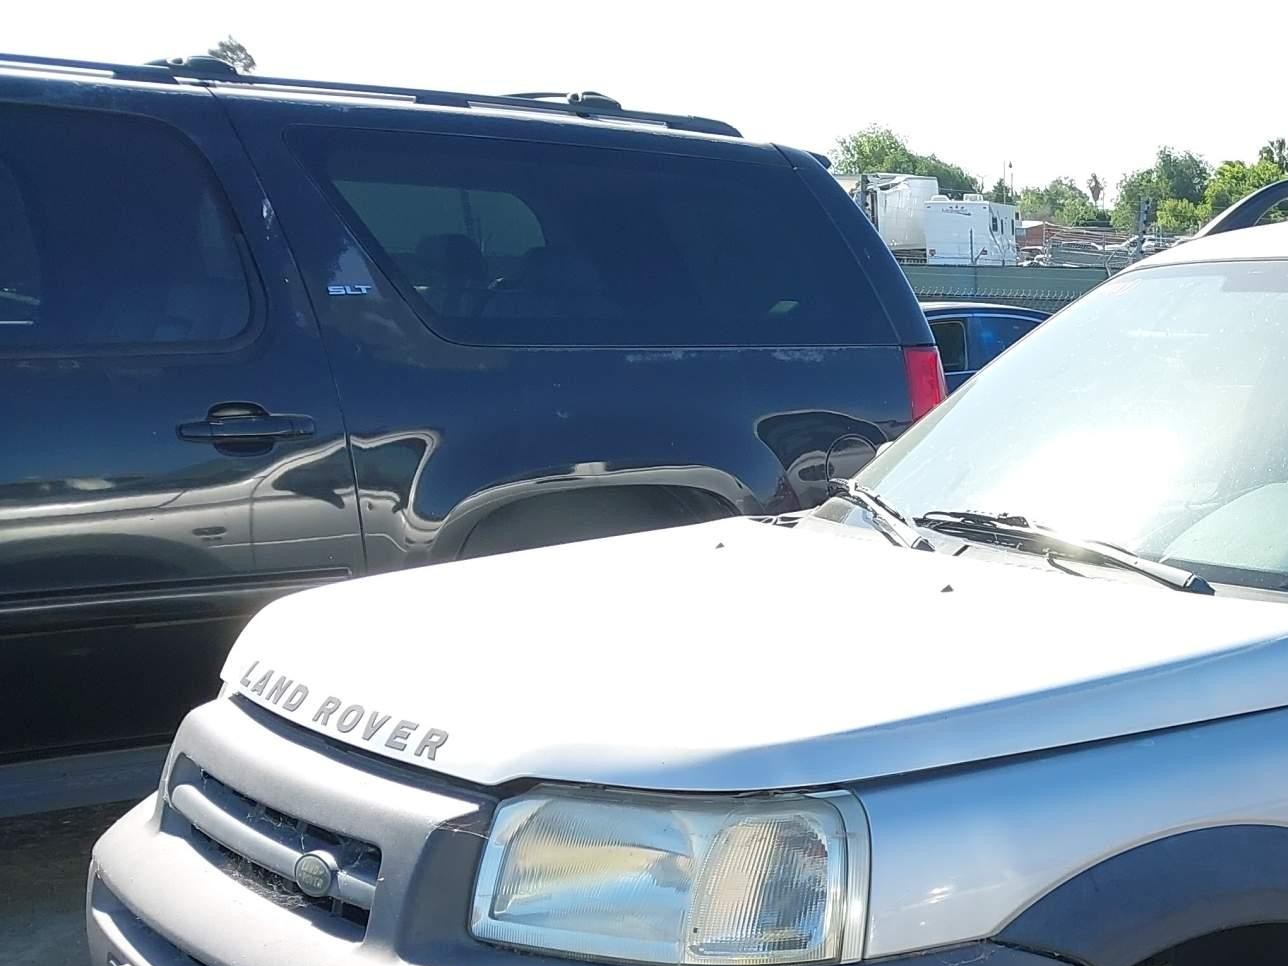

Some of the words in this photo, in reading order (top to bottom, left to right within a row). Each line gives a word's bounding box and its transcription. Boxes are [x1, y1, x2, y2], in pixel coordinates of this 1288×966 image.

[327, 285, 372, 295] SLT
[239, 660, 310, 713] LAND
[312, 695, 449, 761] ROVER
